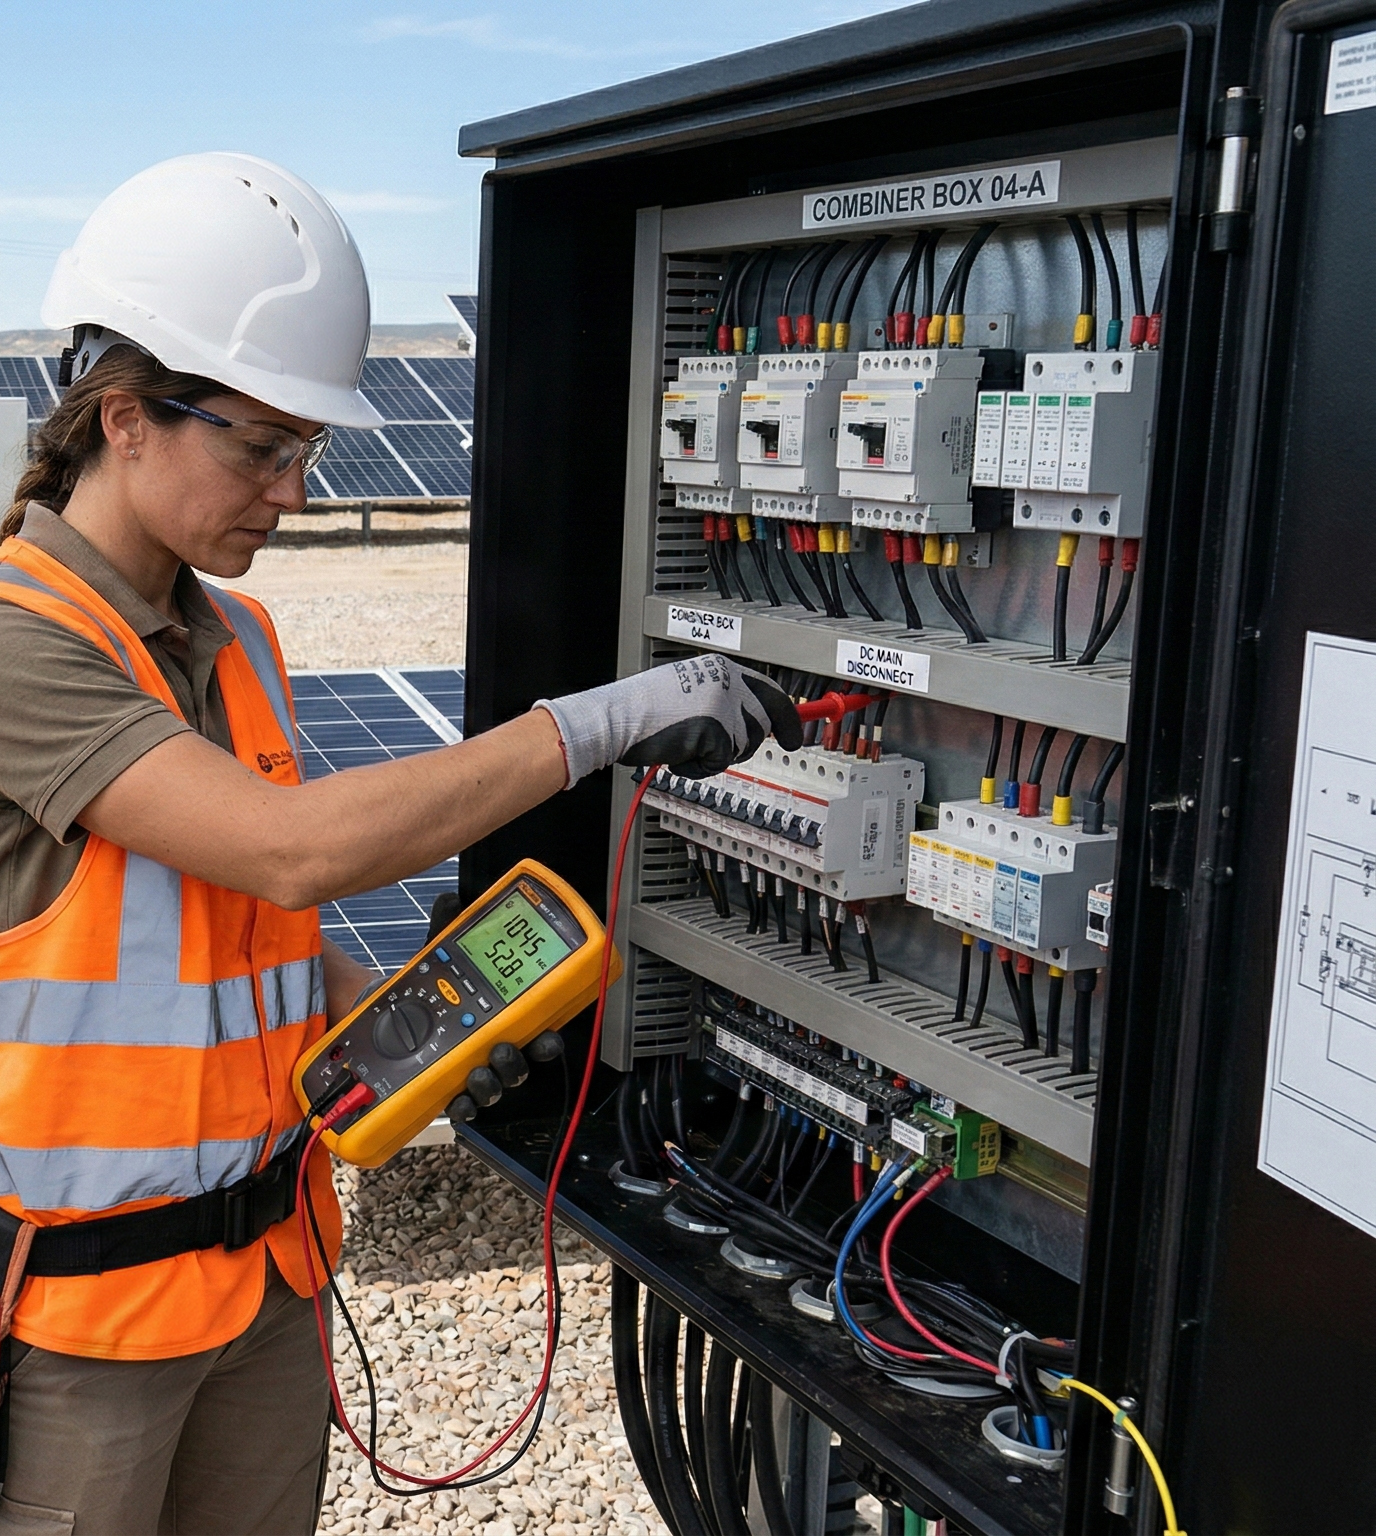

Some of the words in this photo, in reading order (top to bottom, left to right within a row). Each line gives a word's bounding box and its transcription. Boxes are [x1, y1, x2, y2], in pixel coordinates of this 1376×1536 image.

[812, 185, 926, 222] COMBINER
[932, 177, 984, 208] BOX
[990, 170, 1047, 202] 04-A
[847, 660, 914, 686] DISCONNECT
[860, 645, 874, 661] DC
[876, 648, 903, 667] MAIN
[503, 913, 546, 957] 1045
